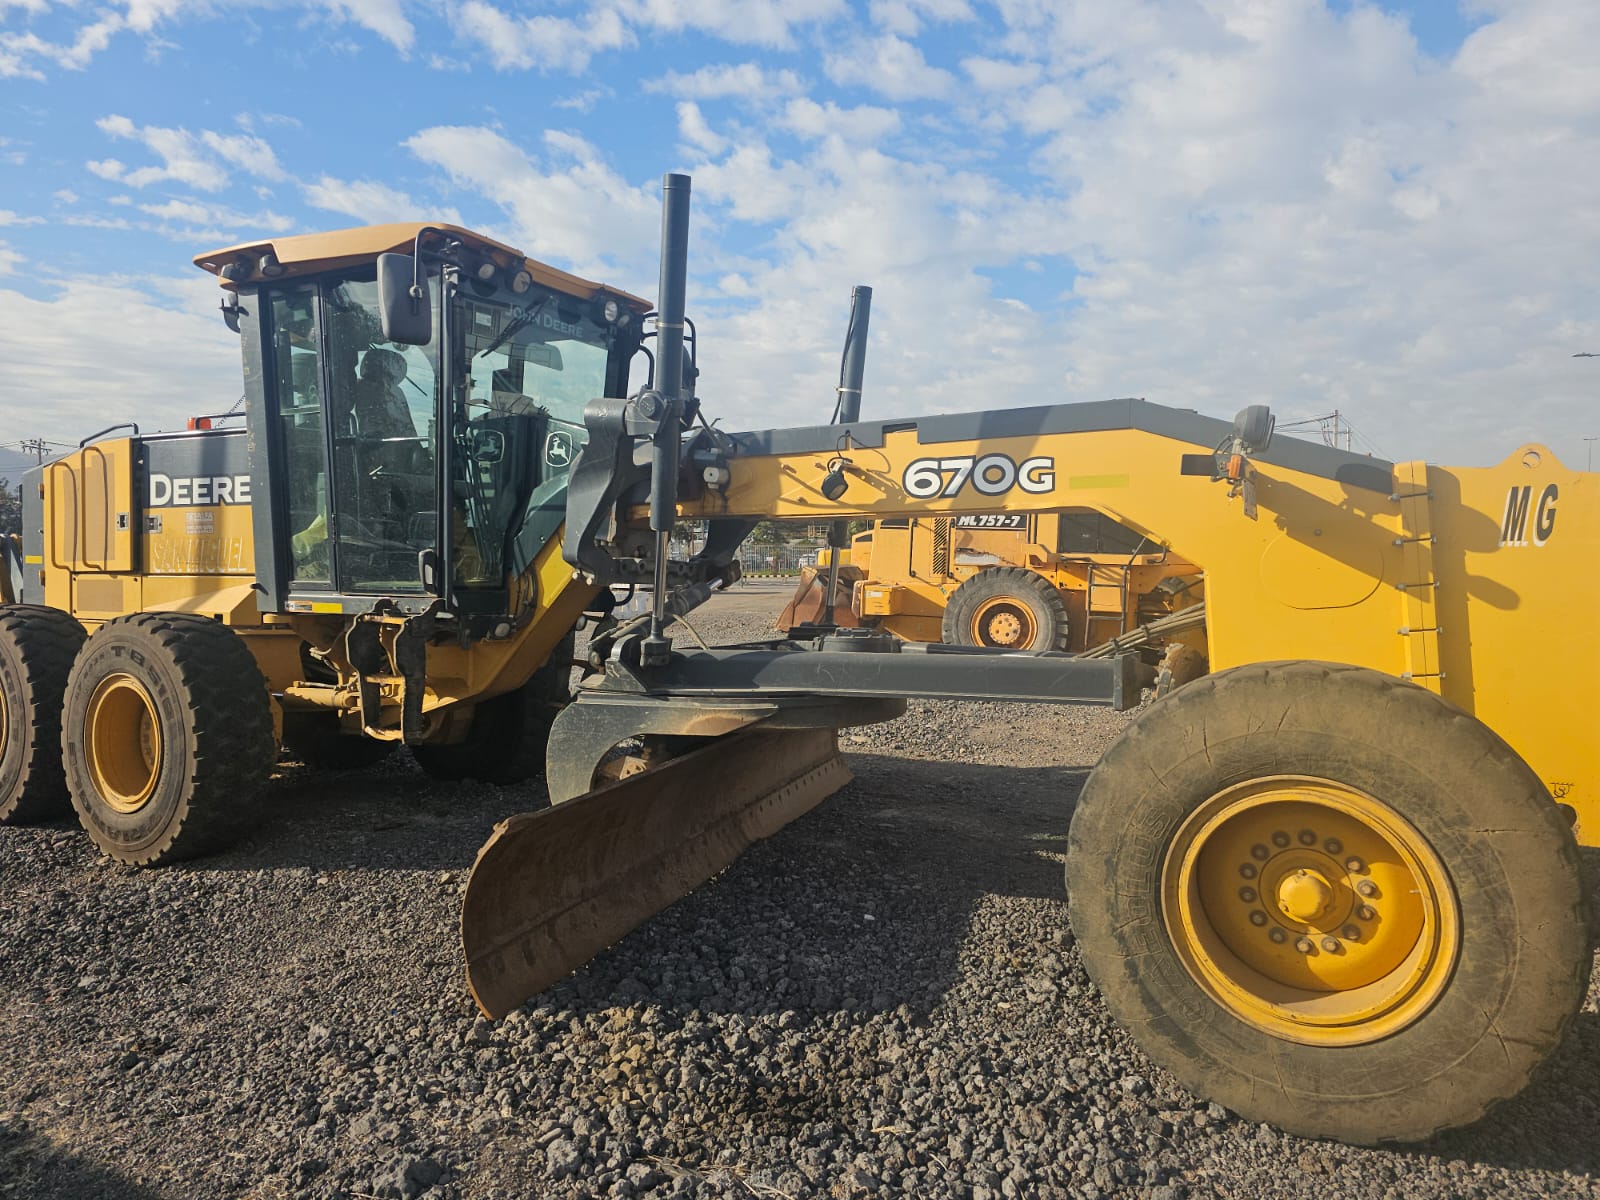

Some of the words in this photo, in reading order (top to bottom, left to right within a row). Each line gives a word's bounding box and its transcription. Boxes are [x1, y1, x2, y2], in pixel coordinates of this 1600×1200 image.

[504, 302, 541, 327] JOHN
[543, 313, 584, 339] DEERE
[149, 474, 252, 506] DEERE
[902, 452, 1055, 499] 670G
